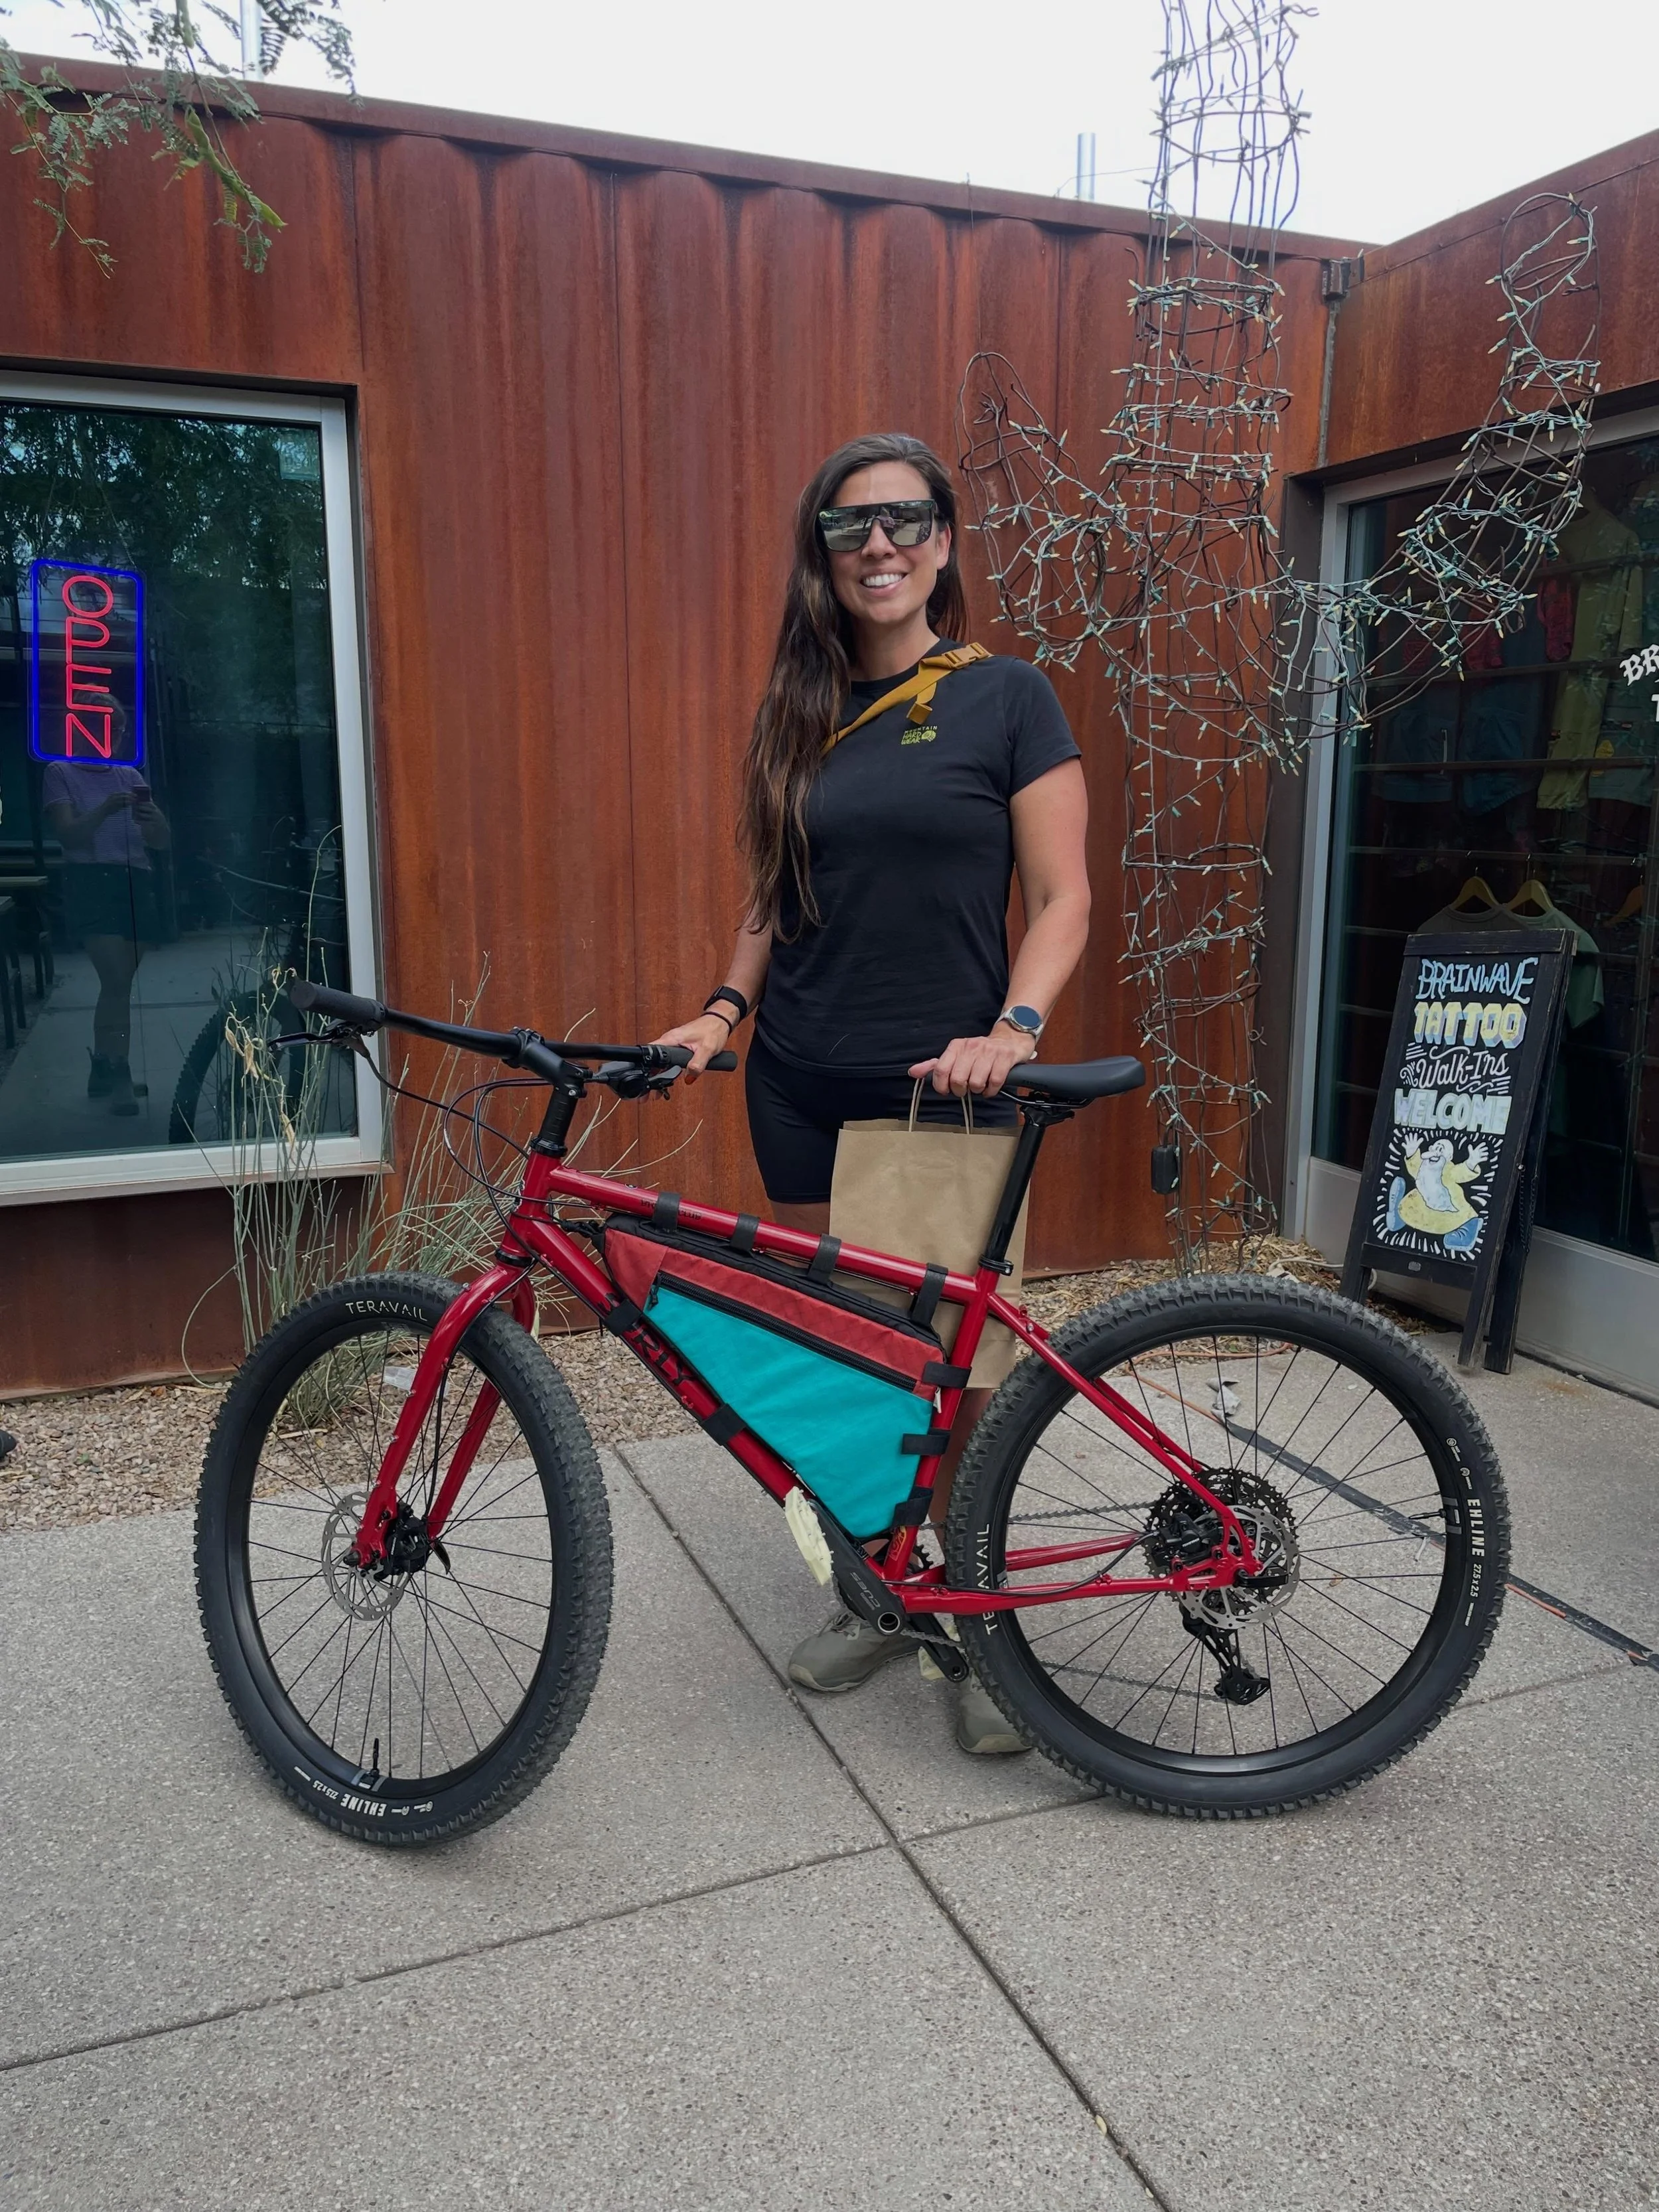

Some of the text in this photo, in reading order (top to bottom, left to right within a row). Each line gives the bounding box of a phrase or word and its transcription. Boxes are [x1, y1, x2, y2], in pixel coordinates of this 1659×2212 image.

[62, 575, 114, 759] OPEN
[904, 725, 938, 734] MOUNTAIN
[1415, 957, 1539, 1005] BRAINWAVE
[1413, 1001, 1527, 1049] TATTOO
[1415, 1050, 1510, 1088] Walk-Ins
[1394, 1088, 1512, 1135] WELCOME
[345, 1300, 428, 1322] TERAVAIL
[1467, 1498, 1486, 1558] EHLINE
[850, 1572, 881, 1607] CUES
[976, 1524, 998, 1635] TEAVAIL
[340, 1793, 387, 1817] EHLINE
